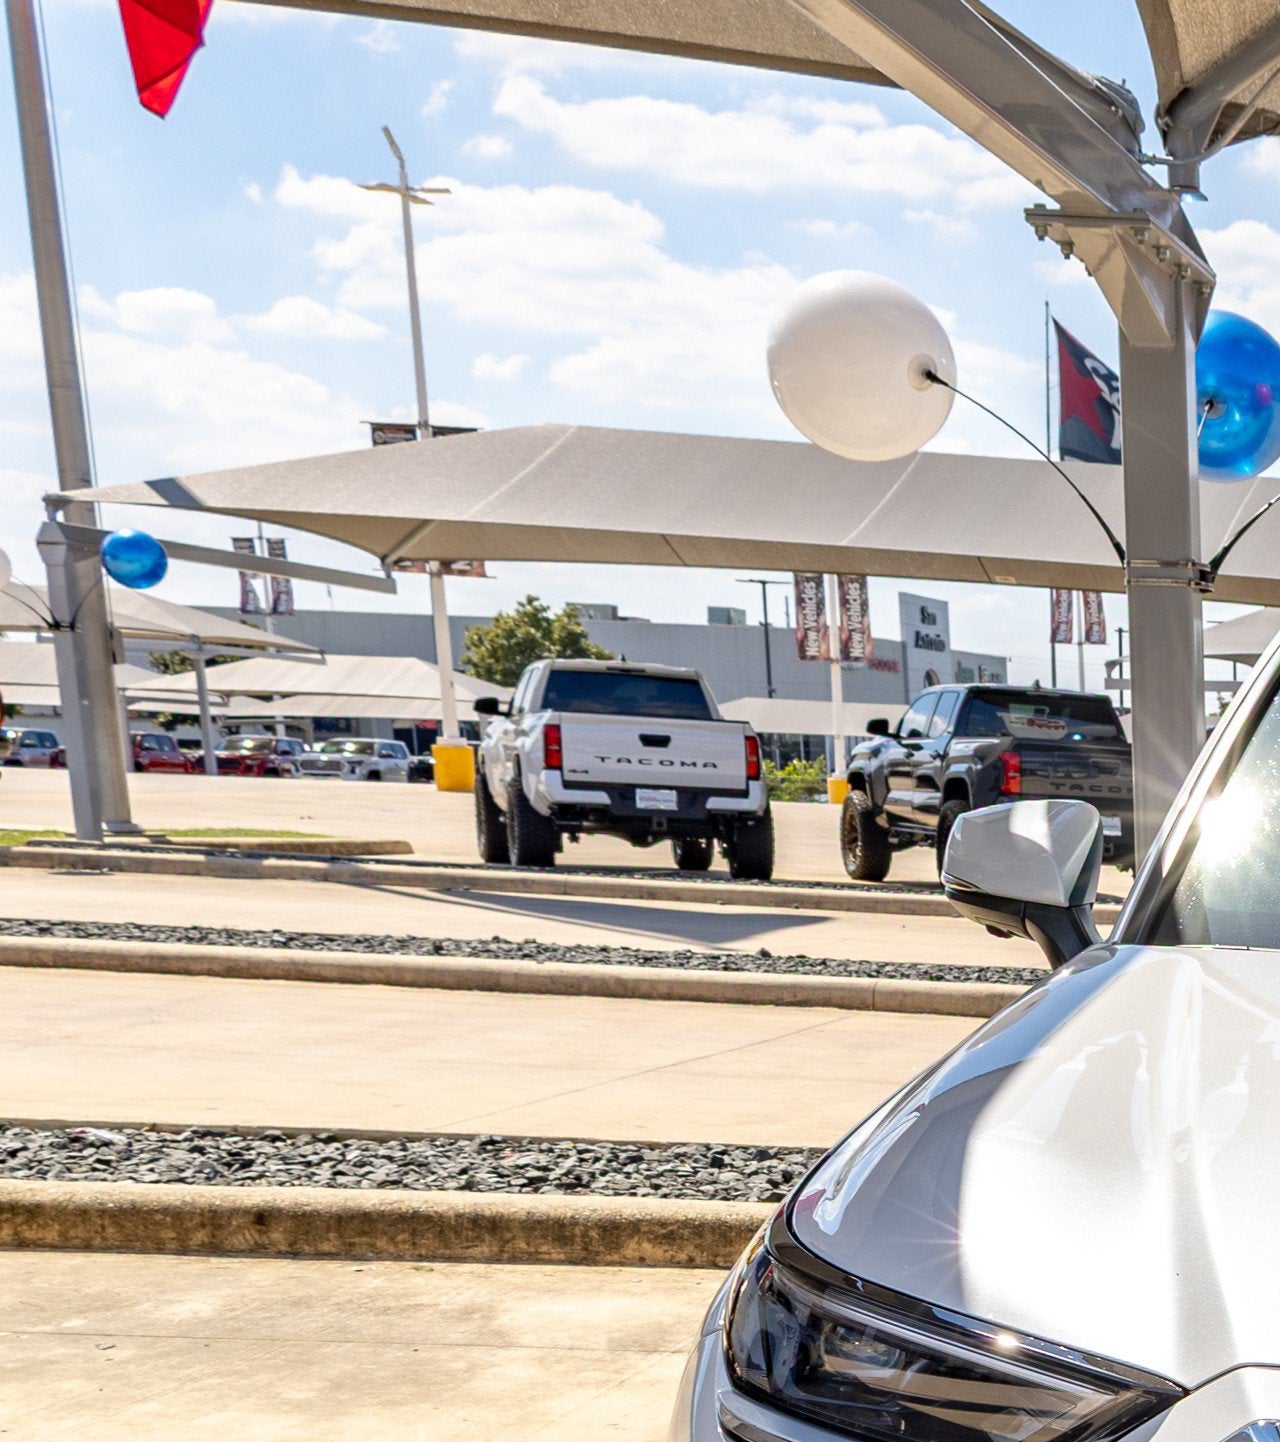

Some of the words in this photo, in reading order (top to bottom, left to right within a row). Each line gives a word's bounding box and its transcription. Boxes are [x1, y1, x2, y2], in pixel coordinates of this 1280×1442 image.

[801, 581, 818, 629] Vehicles
[845, 582, 863, 630] Vehicles
[804, 631, 820, 656] New
[849, 632, 864, 657] New
[594, 755, 718, 769] TACOMA
[1050, 782, 1133, 795] TACO
